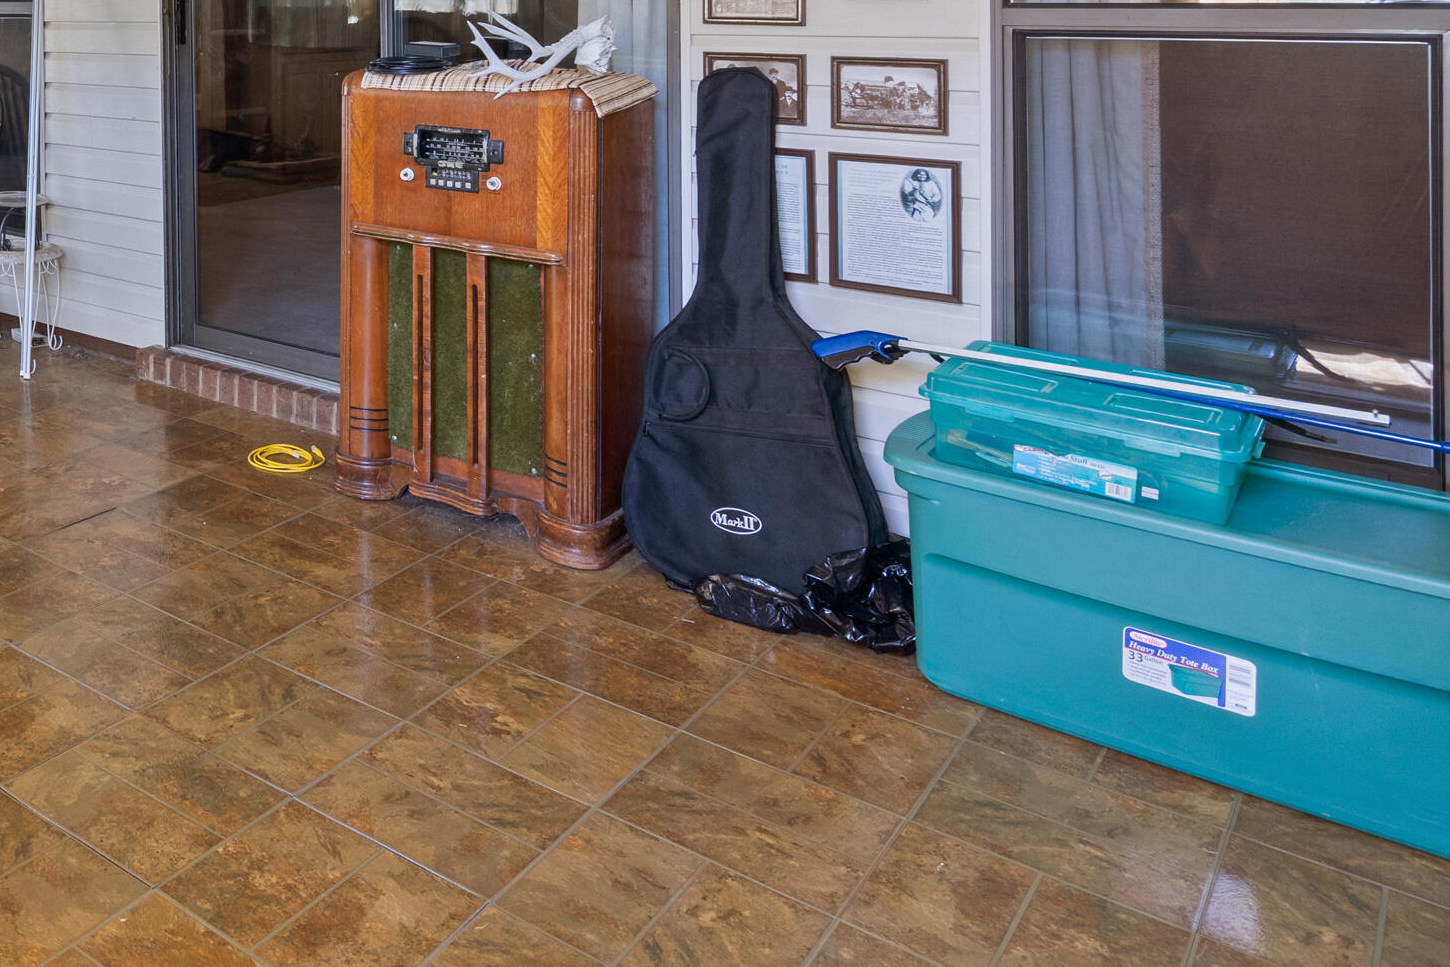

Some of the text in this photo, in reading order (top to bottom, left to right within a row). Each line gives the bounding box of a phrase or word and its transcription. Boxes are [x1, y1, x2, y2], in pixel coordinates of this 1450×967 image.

[1127, 650, 1144, 663] 33
[1128, 640, 1220, 674] Heavy Duty Tote Box
